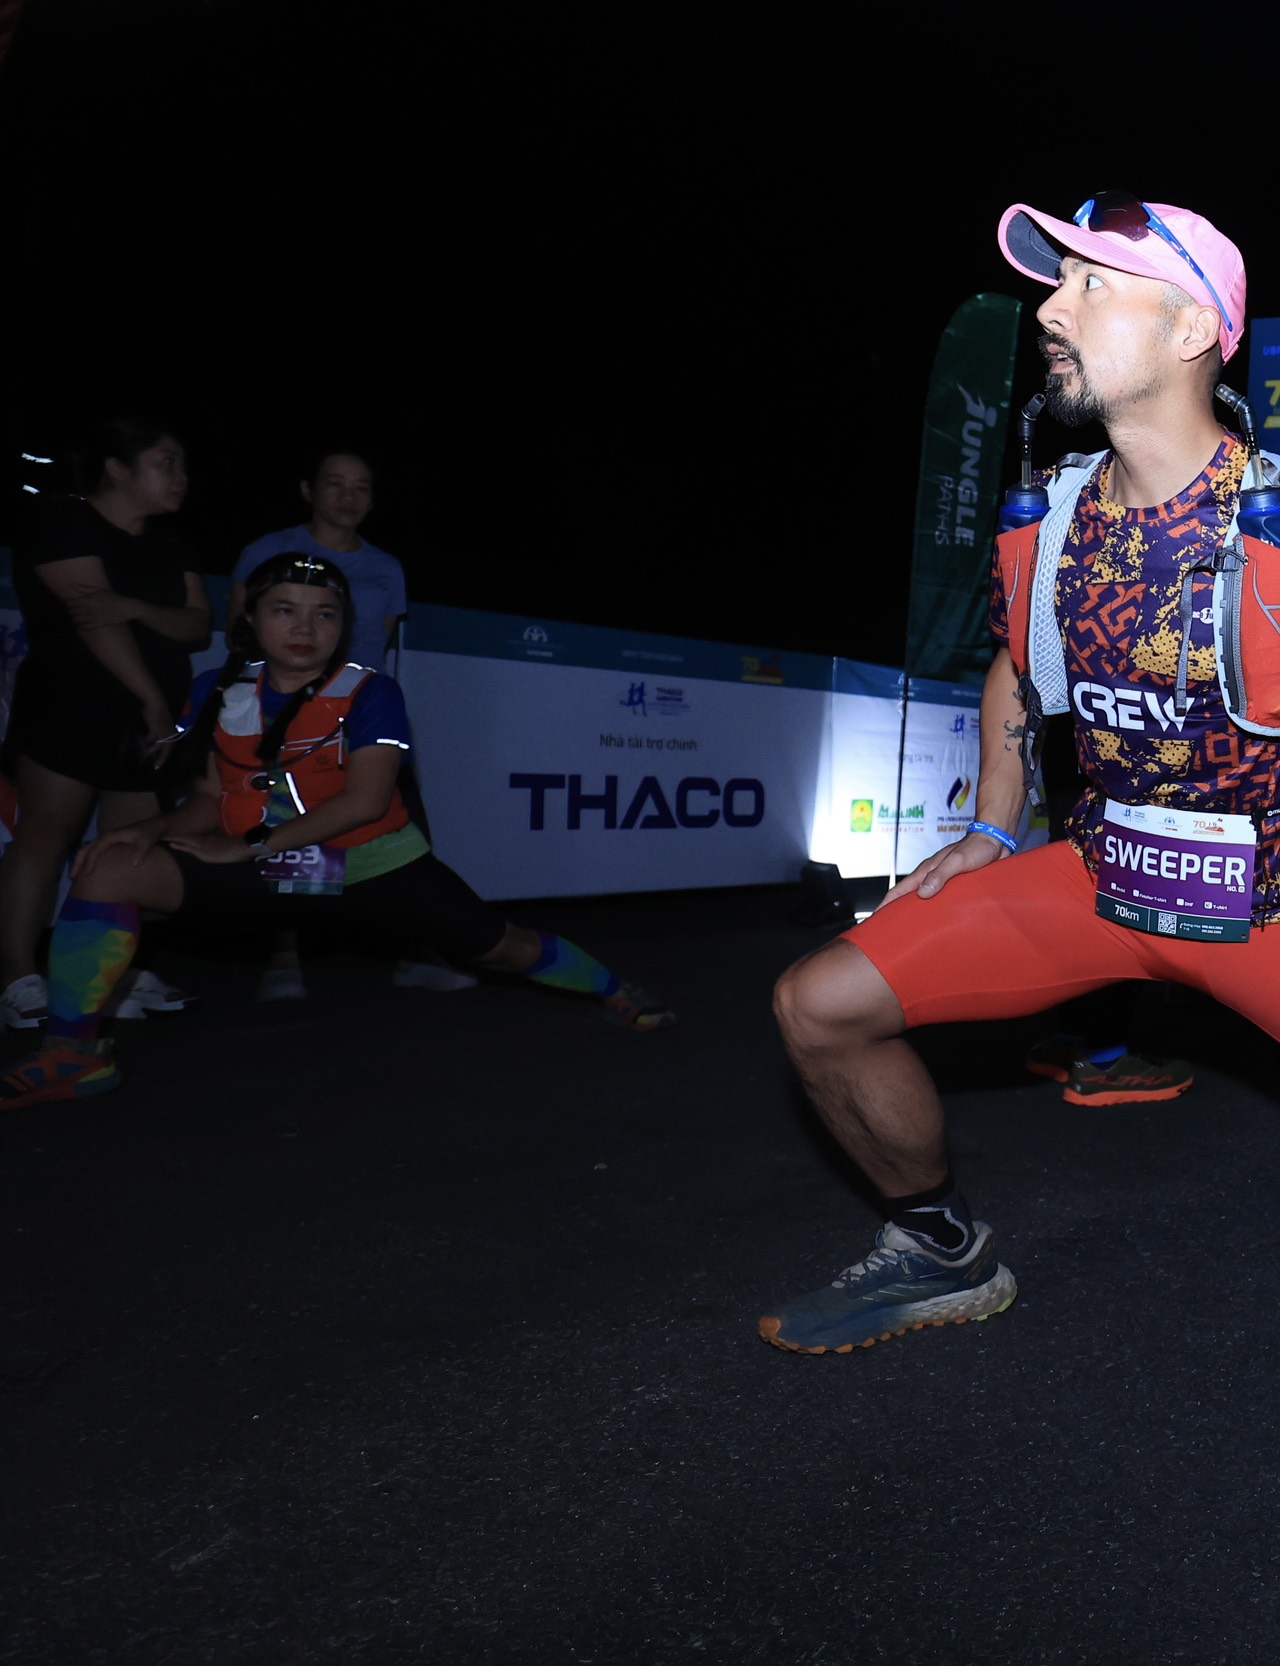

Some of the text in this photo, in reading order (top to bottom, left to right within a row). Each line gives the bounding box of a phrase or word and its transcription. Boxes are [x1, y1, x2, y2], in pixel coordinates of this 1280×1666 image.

[955, 384, 998, 547] JUNGLE
[934, 474, 954, 545] PATHS
[1073, 681, 1195, 733] CREW
[509, 773, 765, 830] THACO
[1103, 835, 1247, 886] SWEEPER
[1114, 904, 1140, 922] 70km
